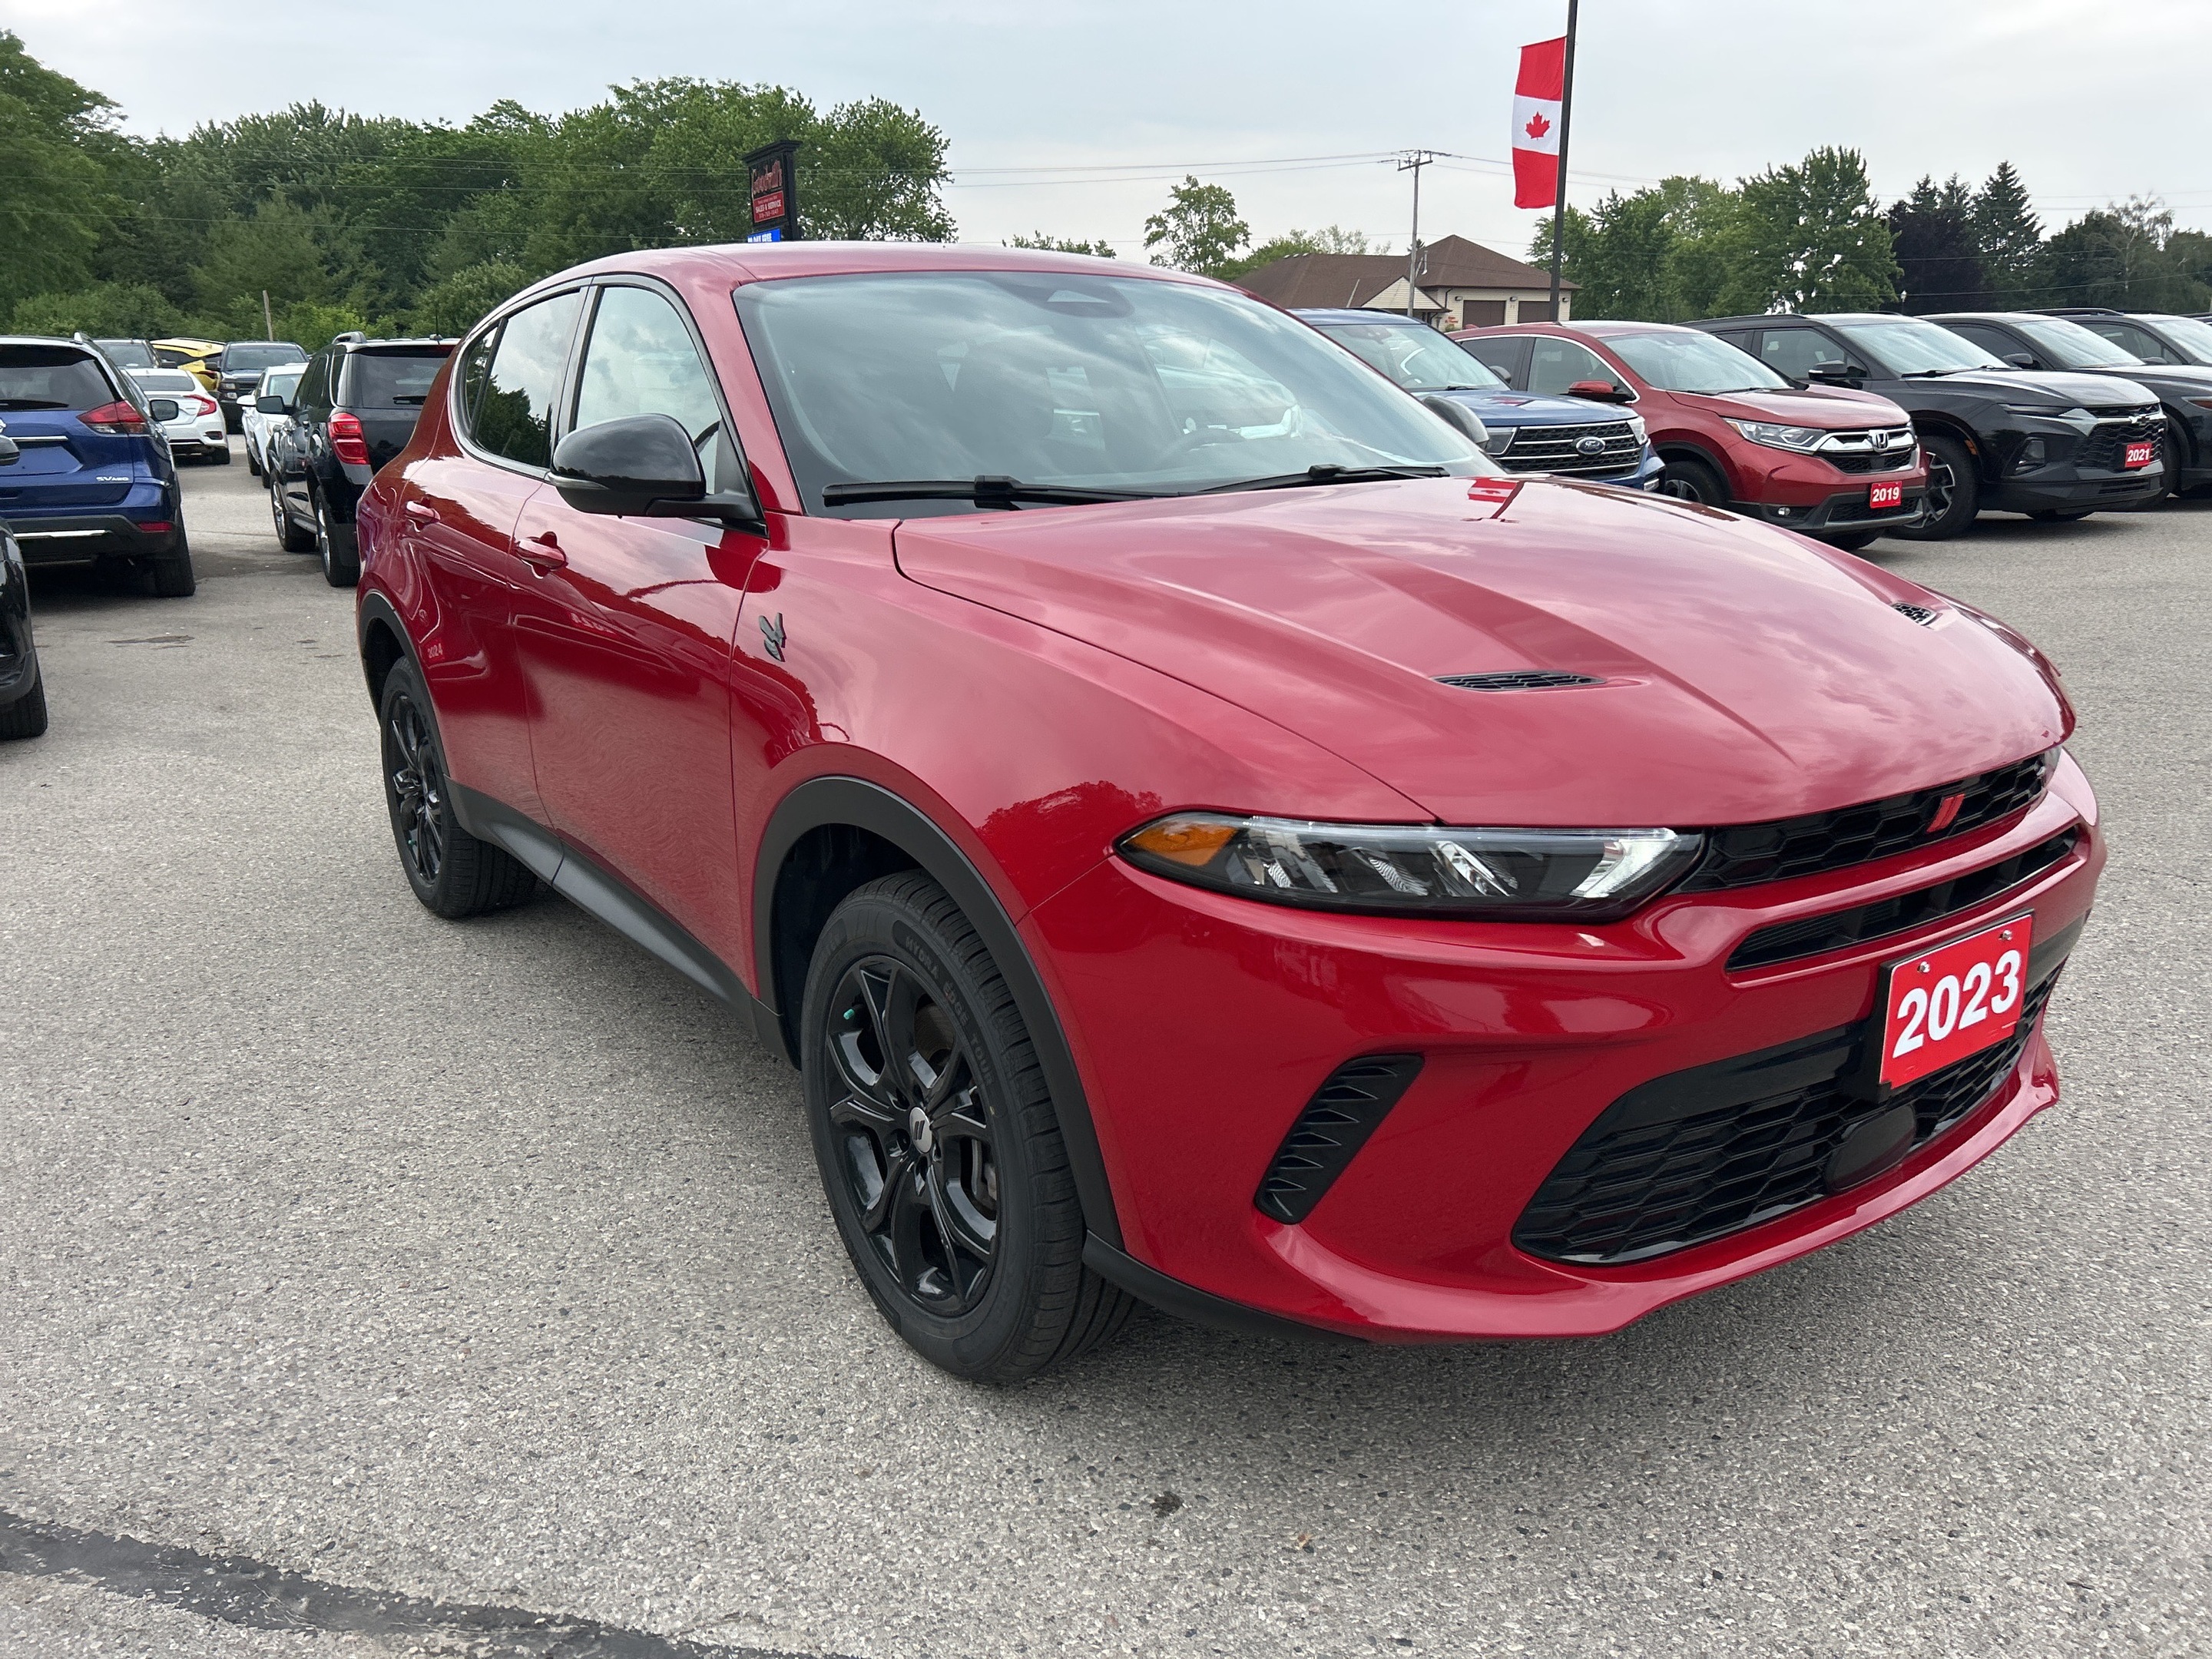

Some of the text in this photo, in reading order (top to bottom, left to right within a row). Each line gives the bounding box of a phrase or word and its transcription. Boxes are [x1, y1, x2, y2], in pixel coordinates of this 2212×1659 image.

[2128, 449, 2150, 462] 2021
[1873, 486, 1899, 502] 2019
[1892, 950, 2022, 1058] 2023
[942, 982, 970, 1028] EDGE
[972, 1031, 995, 1087] TOUR
